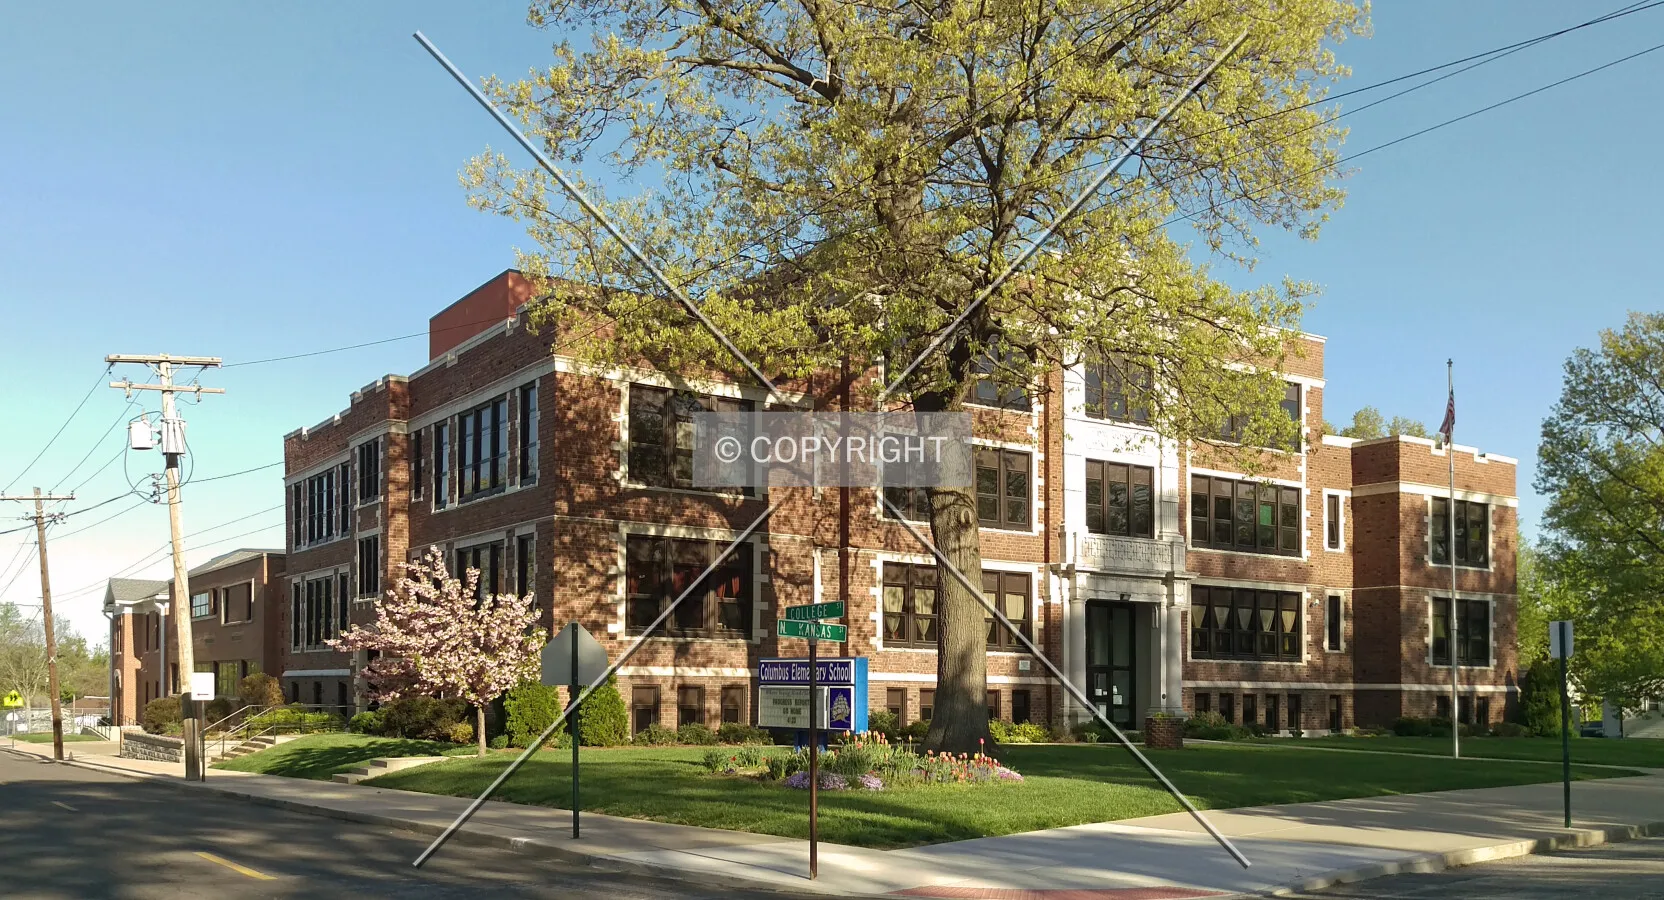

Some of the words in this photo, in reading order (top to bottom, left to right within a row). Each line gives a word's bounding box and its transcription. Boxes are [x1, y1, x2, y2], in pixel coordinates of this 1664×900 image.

[790, 604, 828, 620] COLLEGE
[798, 623, 832, 638] KANSAS
[760, 663, 789, 681] Columbus
[791, 663, 827, 683] Elemeary
[828, 662, 851, 681] School
